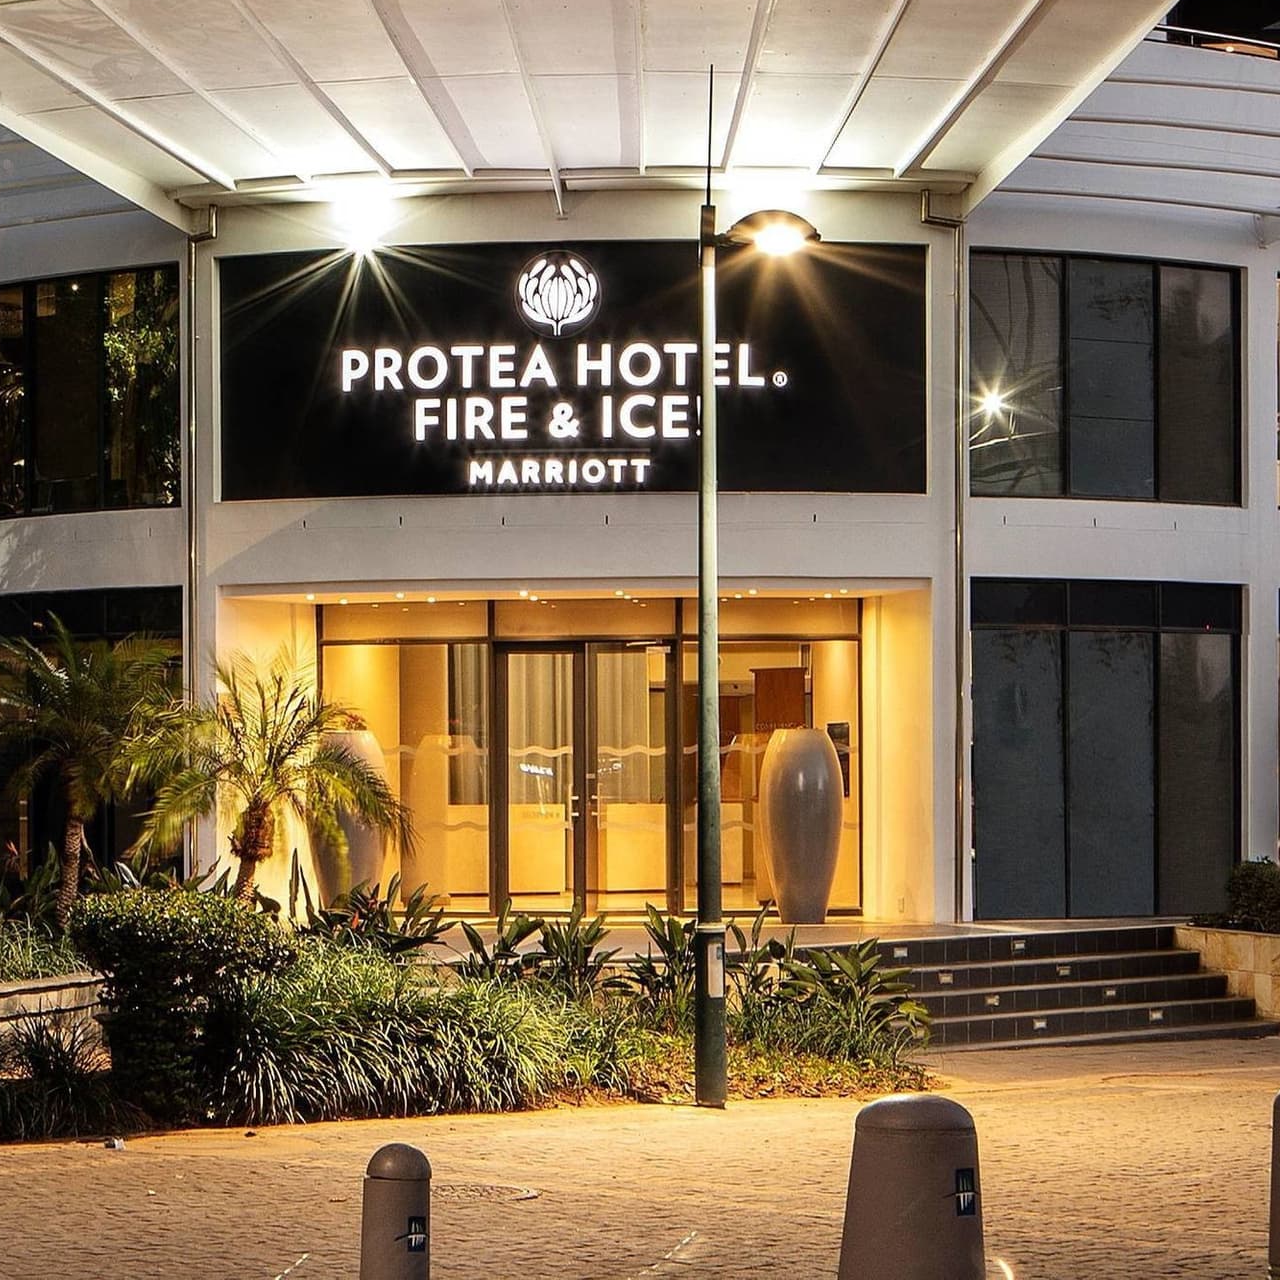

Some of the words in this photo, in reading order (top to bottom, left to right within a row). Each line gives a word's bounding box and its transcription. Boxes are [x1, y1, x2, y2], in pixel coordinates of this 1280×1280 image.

[341, 343, 558, 392] PROTEA
[414, 395, 529, 441] FIRE
[548, 402, 580, 439] &
[469, 457, 651, 486] MARRIOTT
